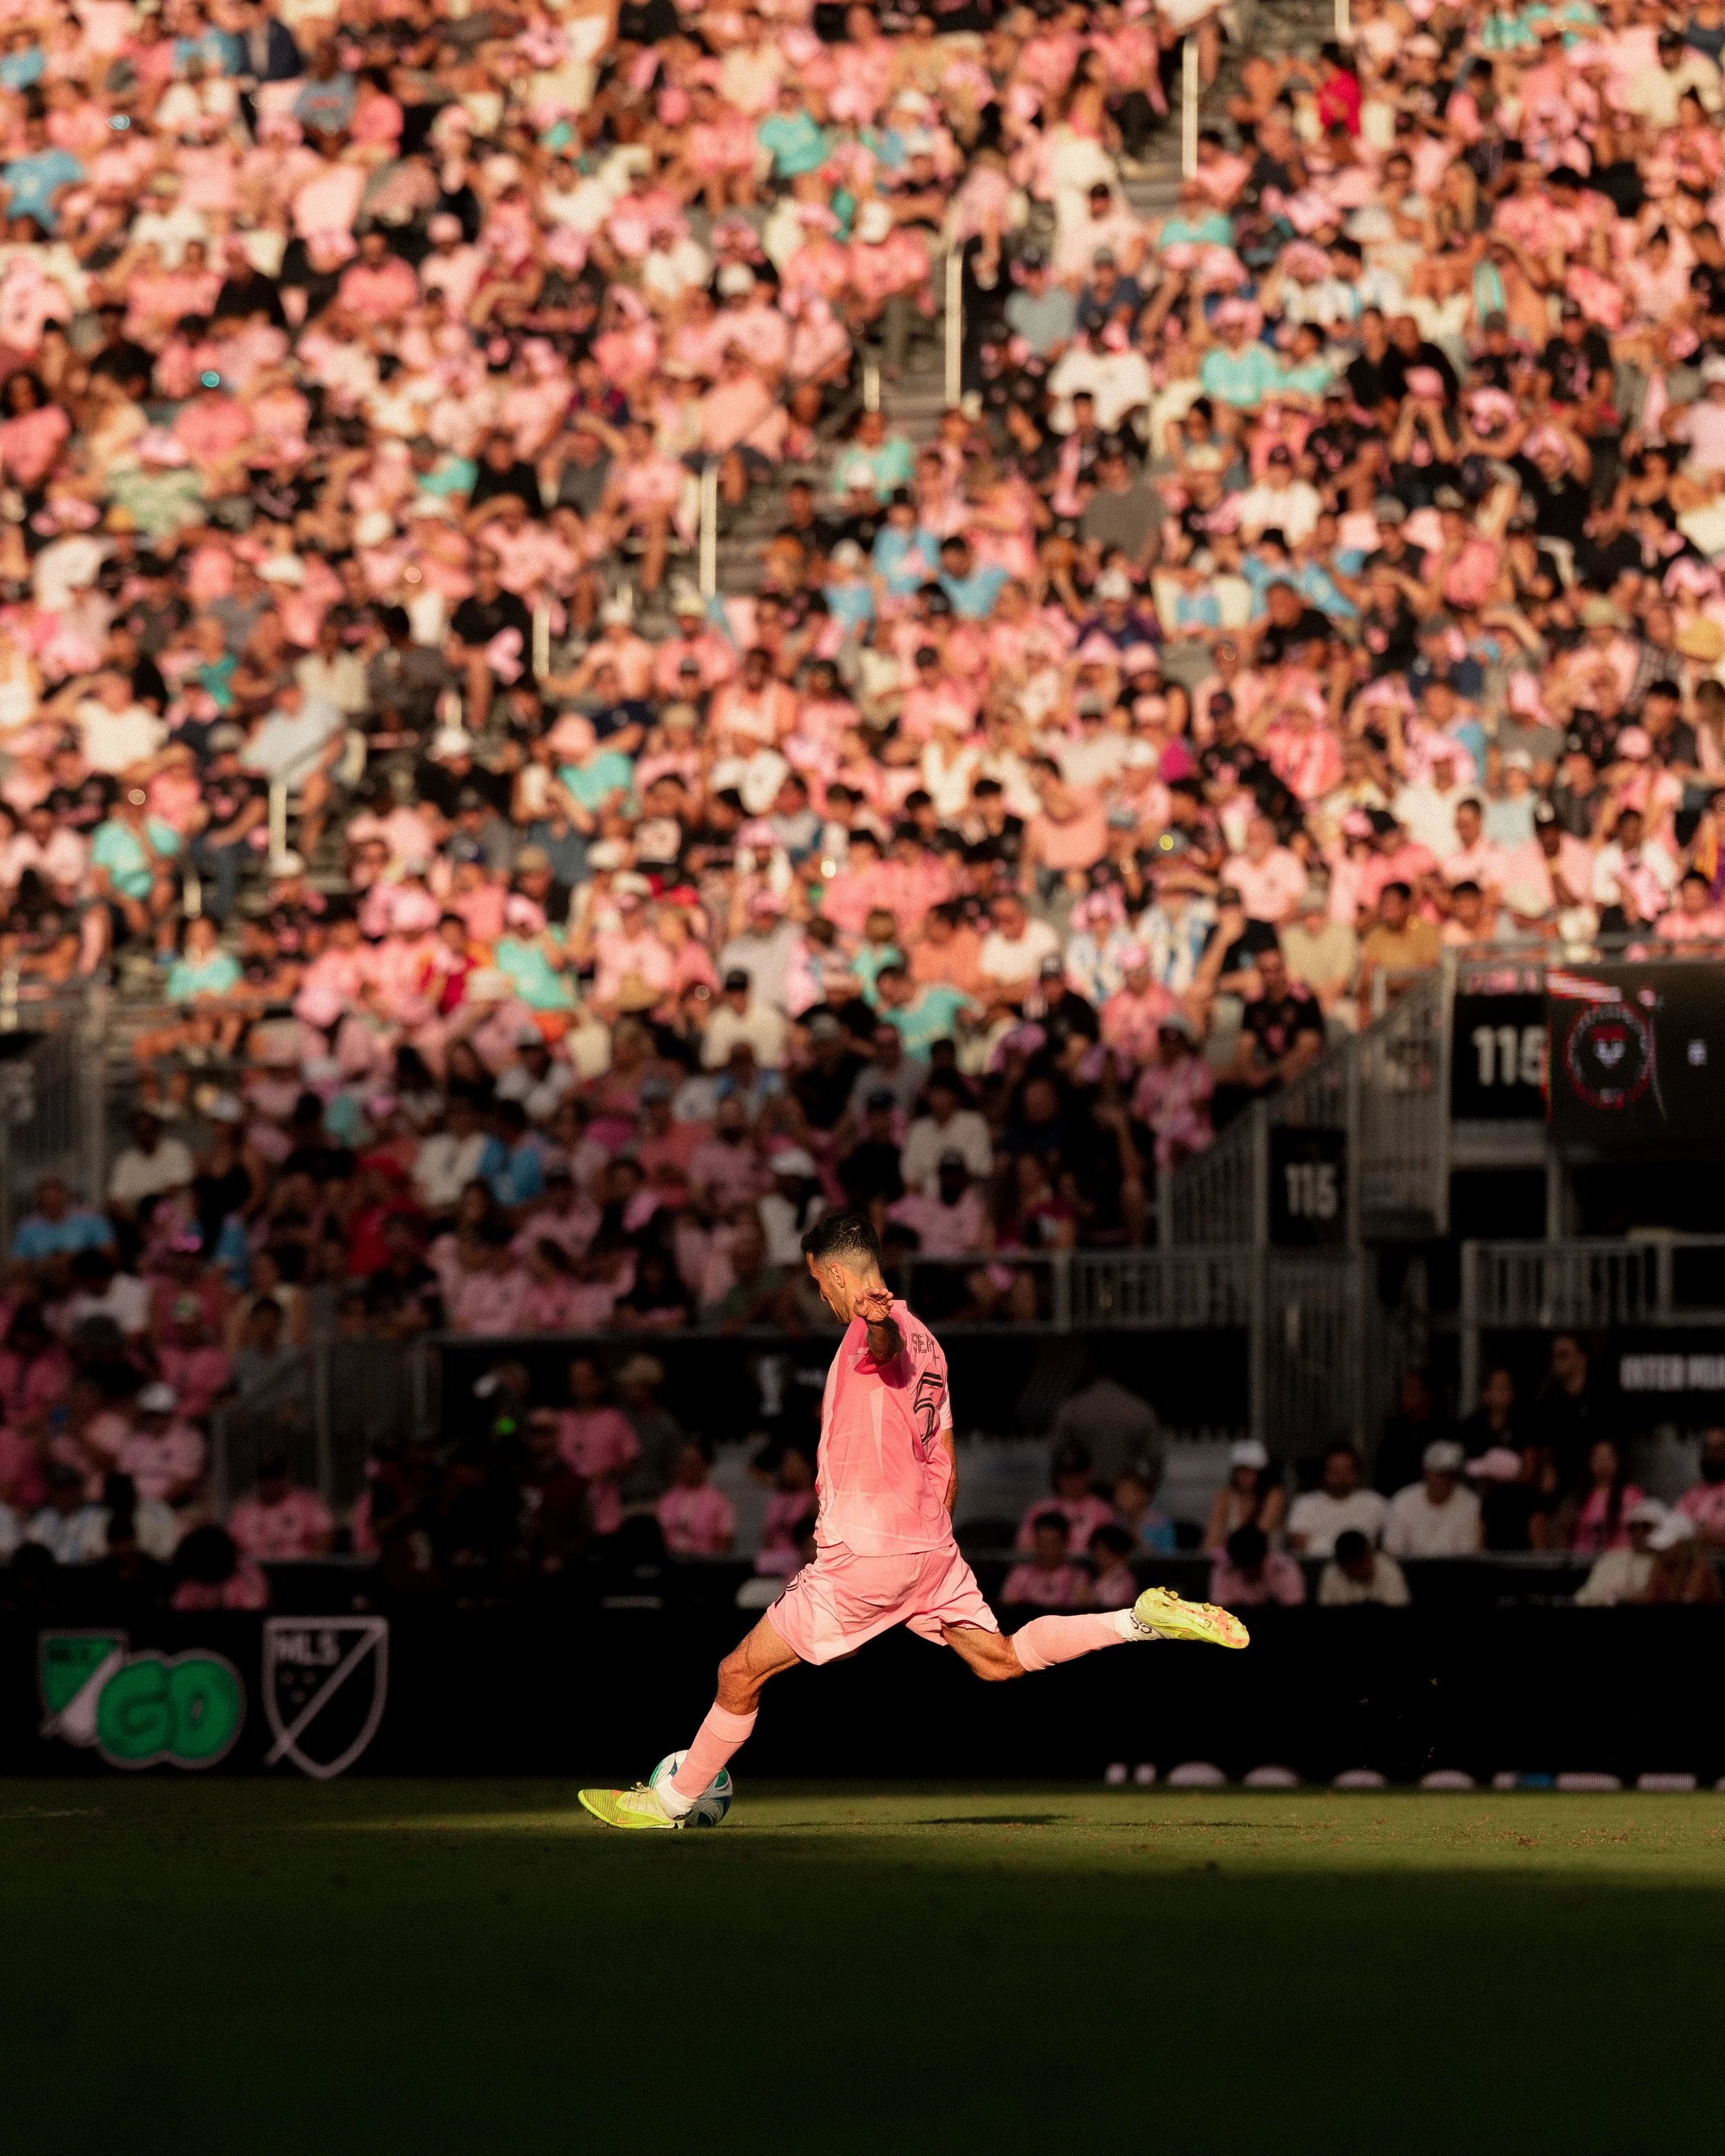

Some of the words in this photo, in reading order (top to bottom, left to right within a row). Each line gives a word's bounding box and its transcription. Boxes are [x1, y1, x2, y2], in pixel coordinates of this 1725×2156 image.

[1472, 1025, 1548, 1087] 115
[1284, 1163, 1337, 1218] 115
[913, 1372, 943, 1445] 5
[277, 1630, 342, 1665] MLS
[95, 1656, 241, 1761] GO
